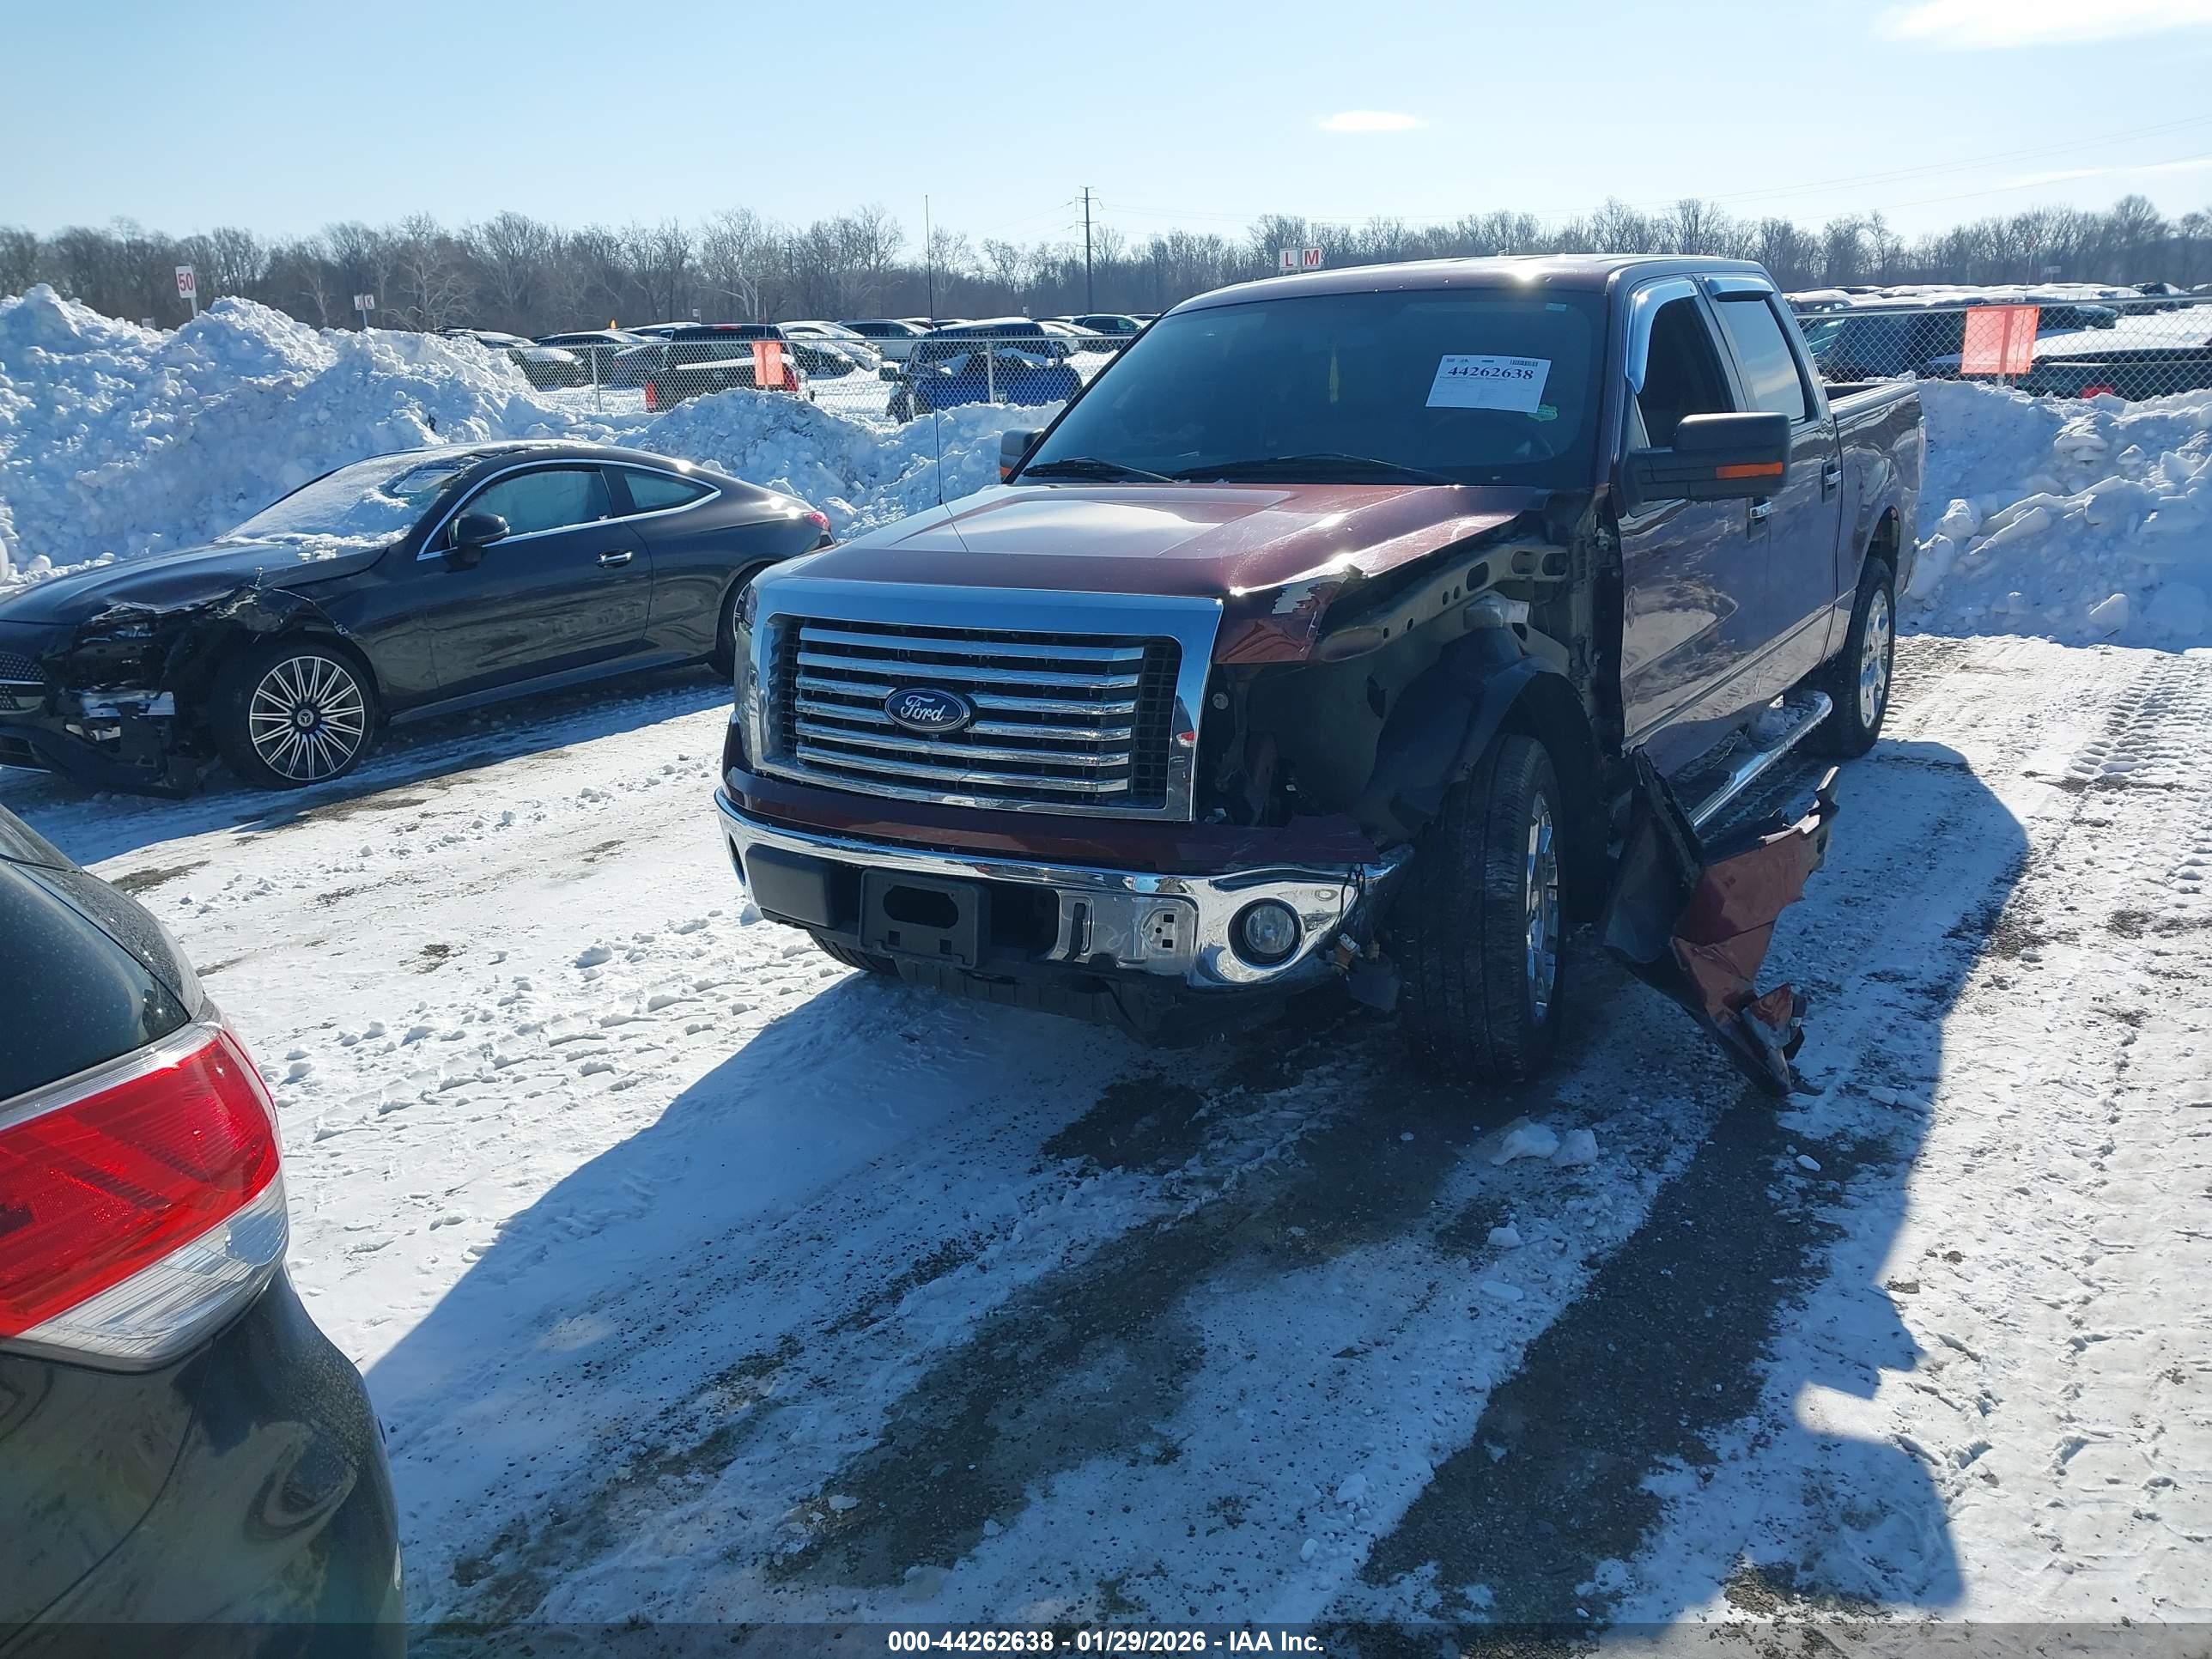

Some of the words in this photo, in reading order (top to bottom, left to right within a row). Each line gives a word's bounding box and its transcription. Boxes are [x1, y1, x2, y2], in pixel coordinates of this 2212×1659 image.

[1285, 252, 1293, 266] L
[1305, 249, 1319, 265] M
[178, 272, 193, 291] 50
[1448, 365, 1534, 380] 44262638
[900, 695, 946, 721] Ford
